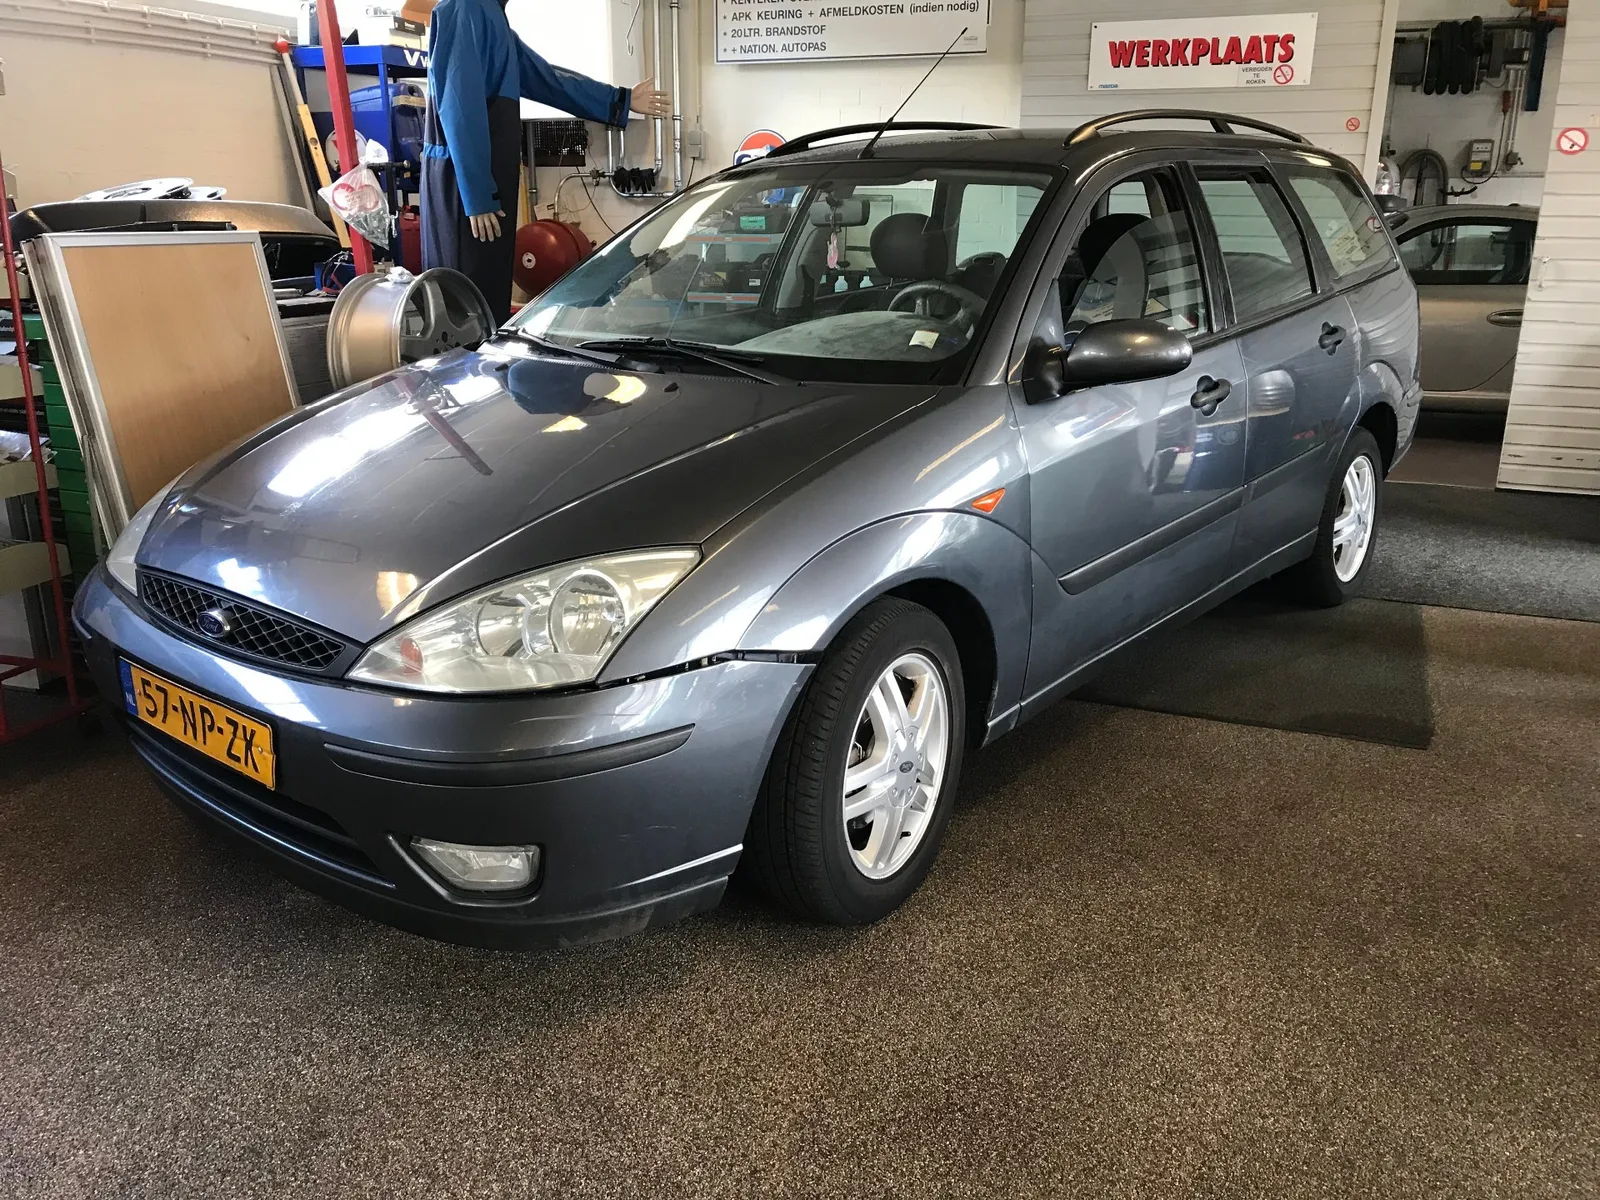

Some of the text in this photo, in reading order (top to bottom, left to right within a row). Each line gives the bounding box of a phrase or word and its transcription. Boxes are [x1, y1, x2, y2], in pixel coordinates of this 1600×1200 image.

[731, 12, 752, 21] APK
[757, 9, 803, 20] KEURING
[819, 4, 904, 18] AFMELDKOSTEN
[909, 3, 944, 13] (indien
[946, 0, 979, 12] nodig)
[765, 25, 826, 37] BRANDSTOF
[739, 44, 778, 54] NATION.
[781, 42, 827, 53] AUTOPAS
[1108, 33, 1295, 68] WERKPLAATS
[140, 677, 260, 775] 57-NP-ZK
